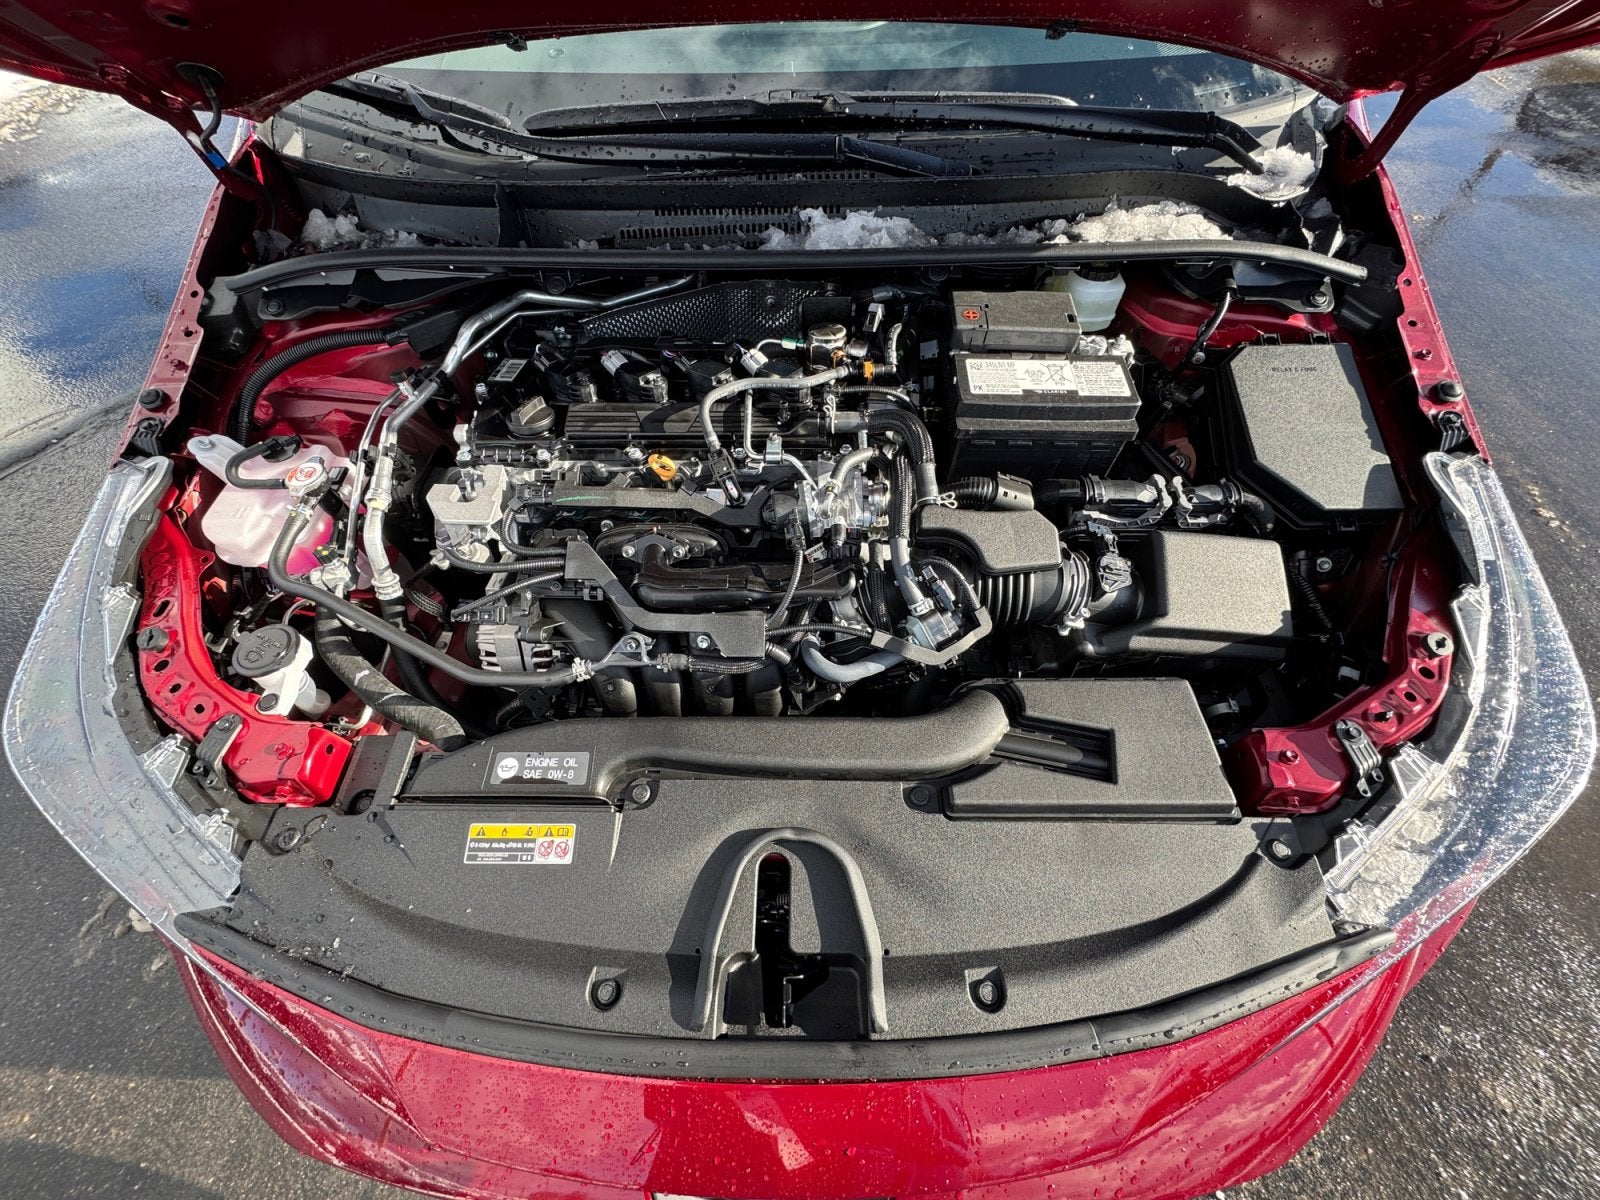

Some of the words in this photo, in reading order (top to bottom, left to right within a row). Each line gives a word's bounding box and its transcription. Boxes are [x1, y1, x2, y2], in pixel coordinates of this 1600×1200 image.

[973, 384, 984, 392] PK
[525, 757, 559, 767] ENGINE
[563, 757, 578, 767] OIL
[522, 769, 542, 779] SAE
[547, 769, 574, 779] 0W-8
